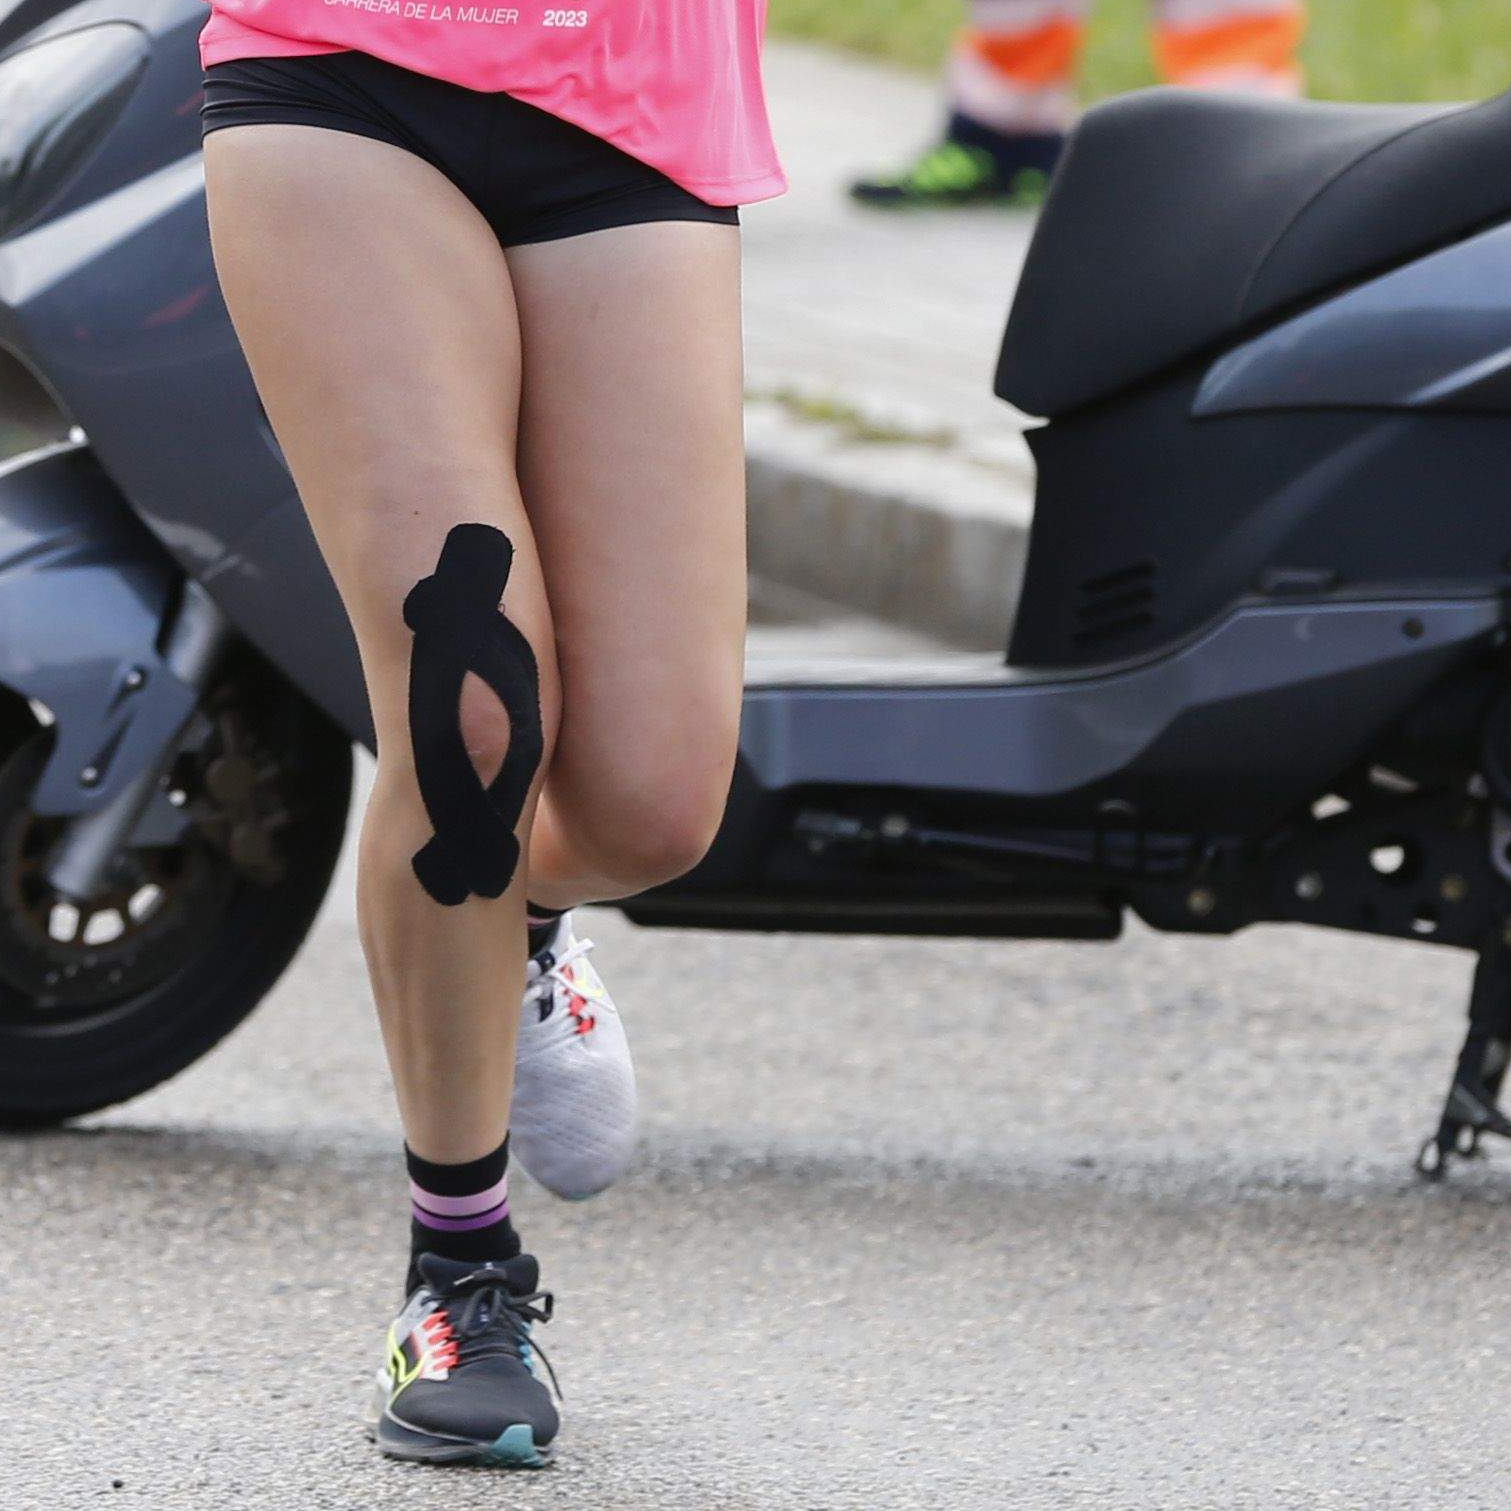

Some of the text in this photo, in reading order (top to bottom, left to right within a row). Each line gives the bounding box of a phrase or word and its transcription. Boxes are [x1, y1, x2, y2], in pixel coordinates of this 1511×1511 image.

[404, 2, 428, 19] DE
[430, 5, 452, 21] LA
[456, 6, 520, 25] MUJER
[543, 9, 588, 28] 2023
